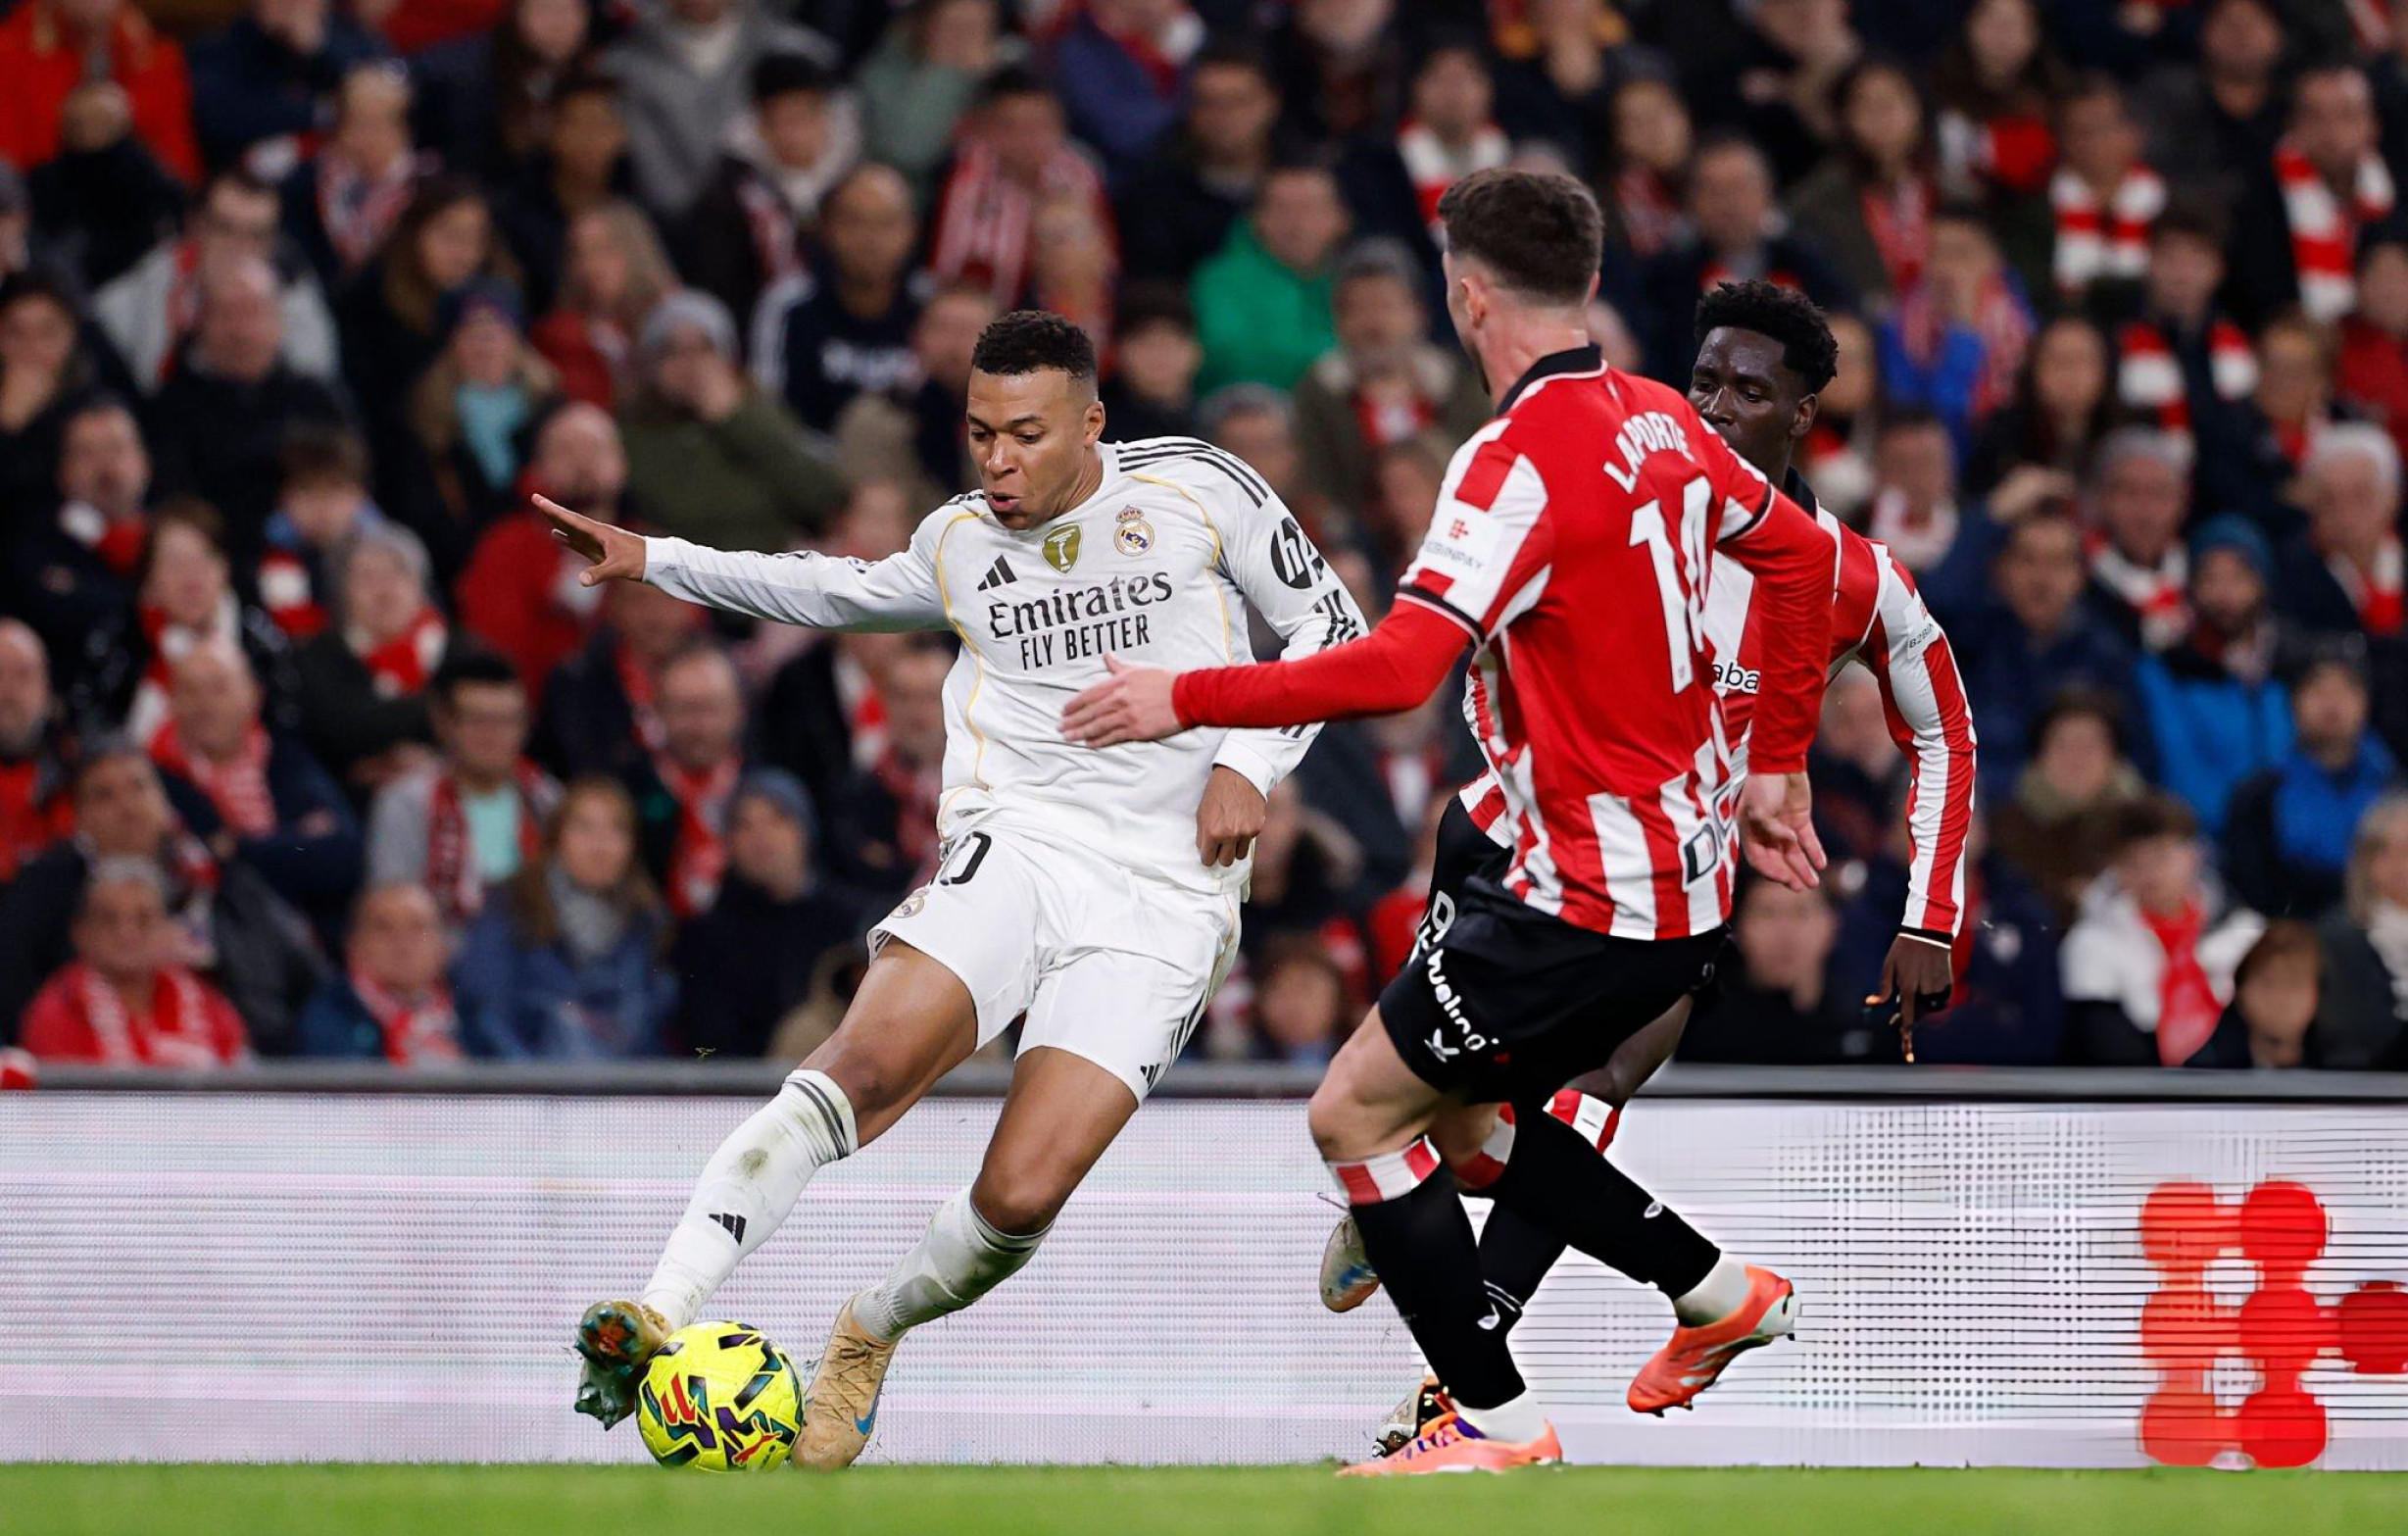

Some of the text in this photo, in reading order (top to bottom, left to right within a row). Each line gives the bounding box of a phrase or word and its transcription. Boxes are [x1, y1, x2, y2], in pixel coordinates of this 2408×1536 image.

[1602, 411, 1696, 494] LAPORTE
[988, 571, 1173, 638] Emirates
[1628, 474, 1712, 694] 14
[1020, 613, 1151, 670] FLY BETTER
